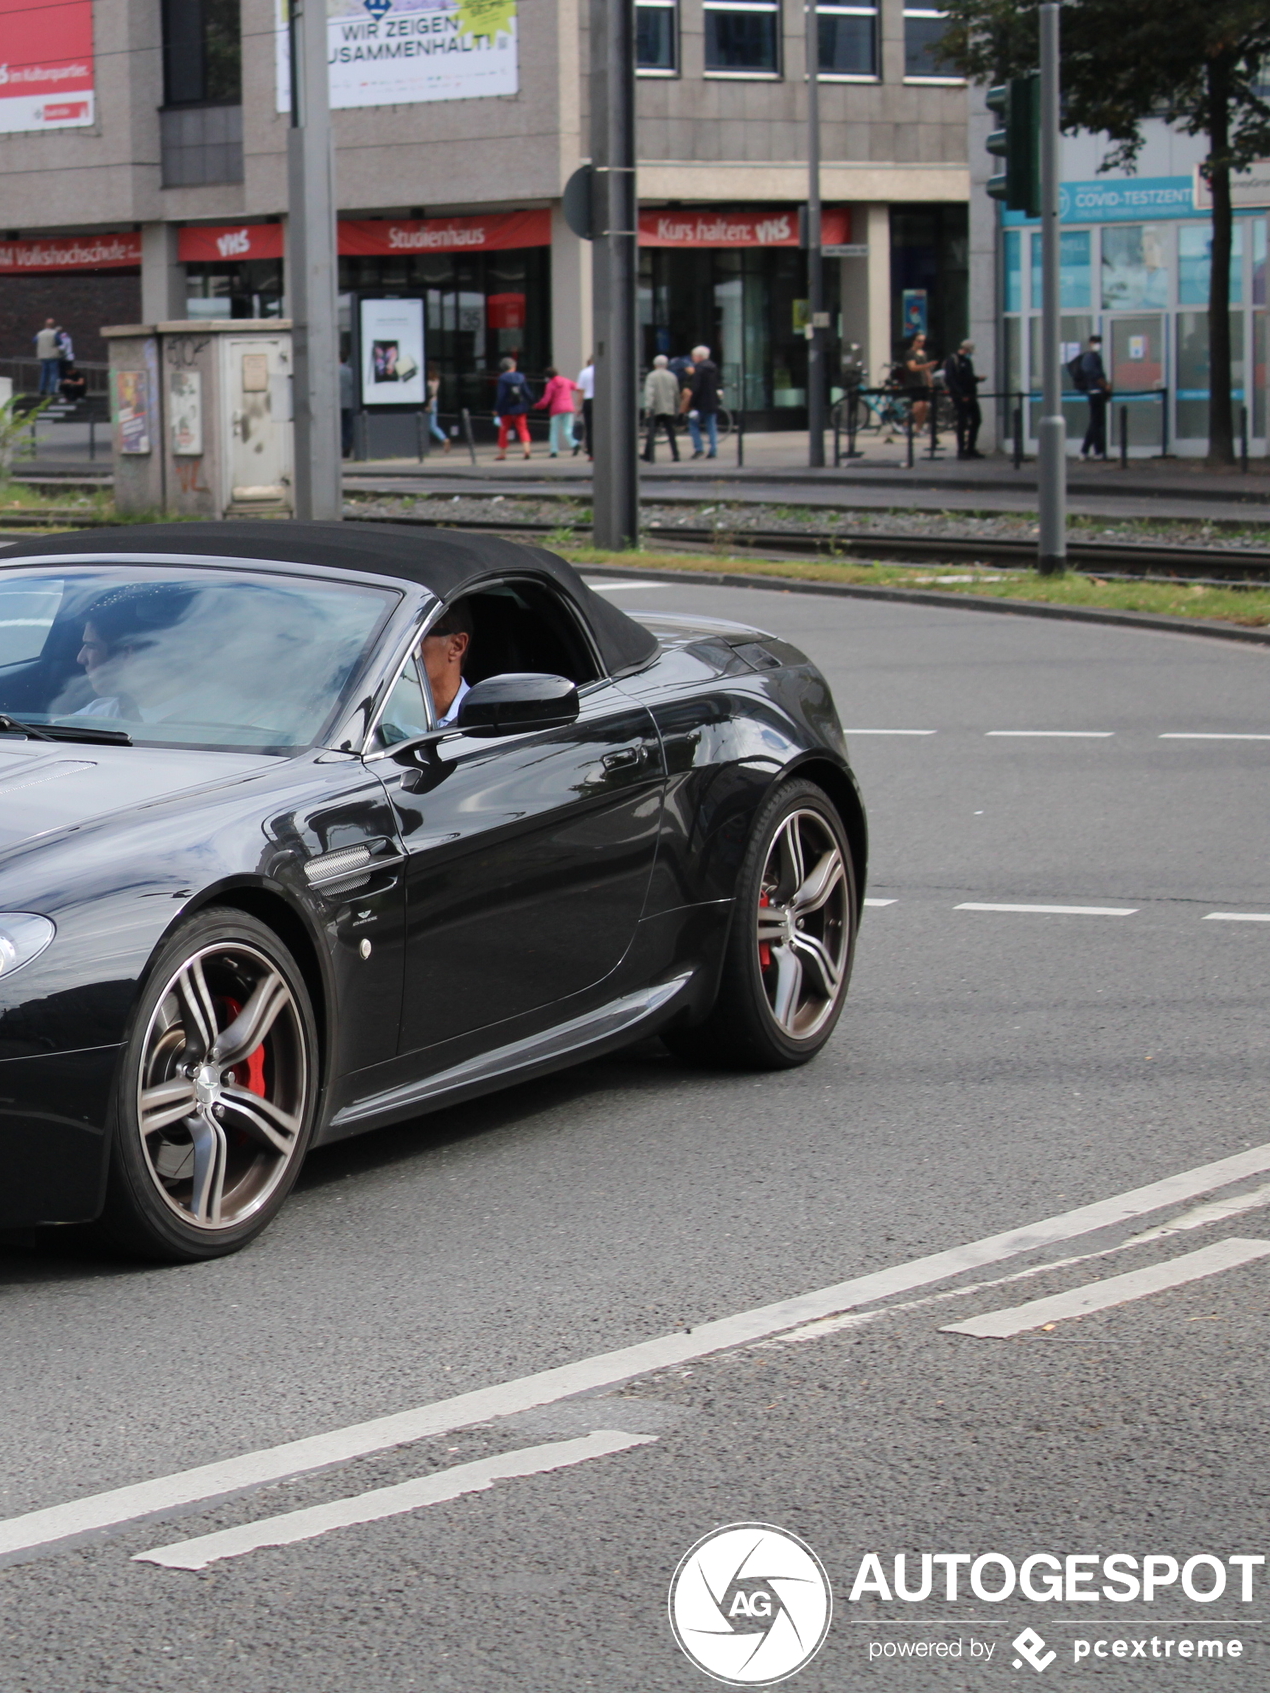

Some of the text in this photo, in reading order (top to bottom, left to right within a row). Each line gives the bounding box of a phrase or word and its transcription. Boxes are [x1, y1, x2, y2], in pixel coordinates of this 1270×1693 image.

[341, 23, 378, 41] WIR
[386, 16, 459, 37] ZEIGEN
[328, 34, 491, 65] USAMMENHALT!
[1075, 188, 1193, 207] COVID-TESTZENT
[217, 229, 250, 257] VHS
[388, 225, 485, 248] Studienhaus
[658, 216, 791, 244] Kurs halten: VHS
[17, 239, 126, 266] Volkshochschule
